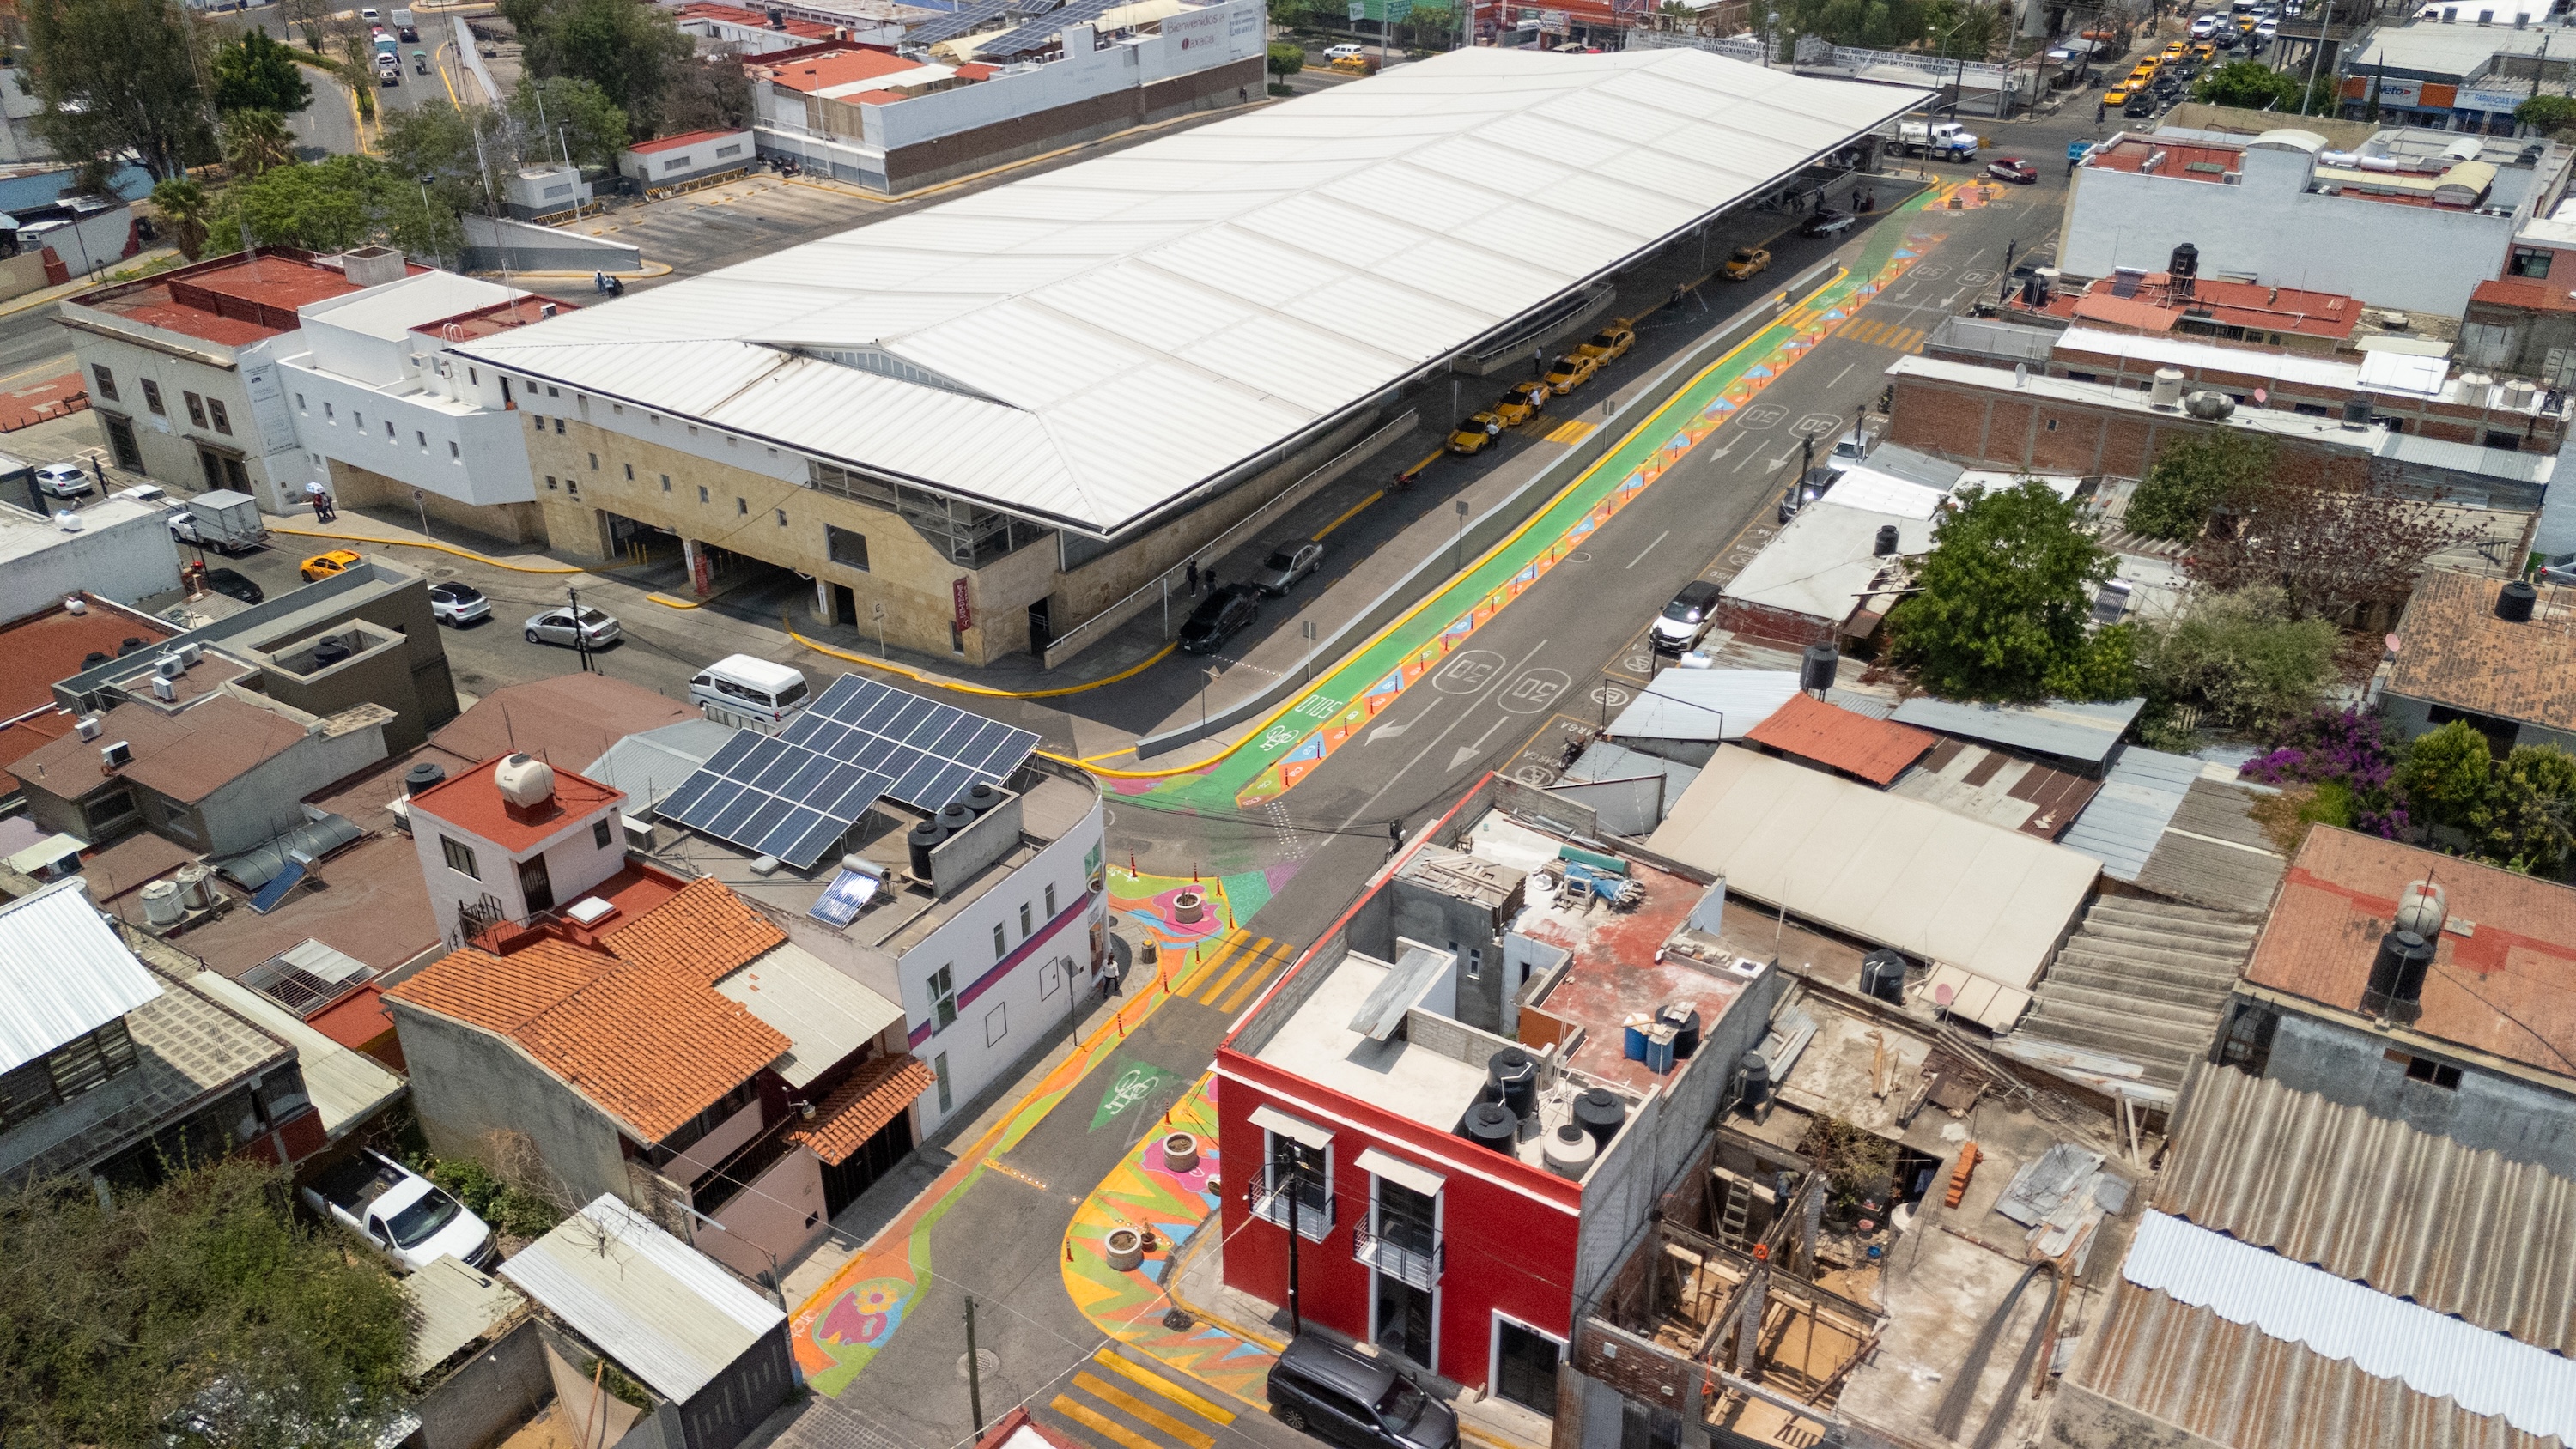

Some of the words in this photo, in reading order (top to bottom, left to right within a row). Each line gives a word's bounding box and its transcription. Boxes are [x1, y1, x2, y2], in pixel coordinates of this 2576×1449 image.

[1168, 15, 1218, 34] Bienvenidos
[1703, 45, 1760, 57] ESTACIONAMIENTO
[1715, 39, 1760, 50] CONFORTABLES
[1905, 55, 1933, 64] SEGURIDAD
[2475, 94, 2510, 106] FARMACIAS
[1746, 410, 1779, 423] 30
[1799, 419, 1832, 433] 30
[1447, 659, 1492, 683] 30
[1512, 678, 1558, 703] 30
[1295, 694, 1343, 718] SOLO
[1559, 720, 1596, 737] ARGA
